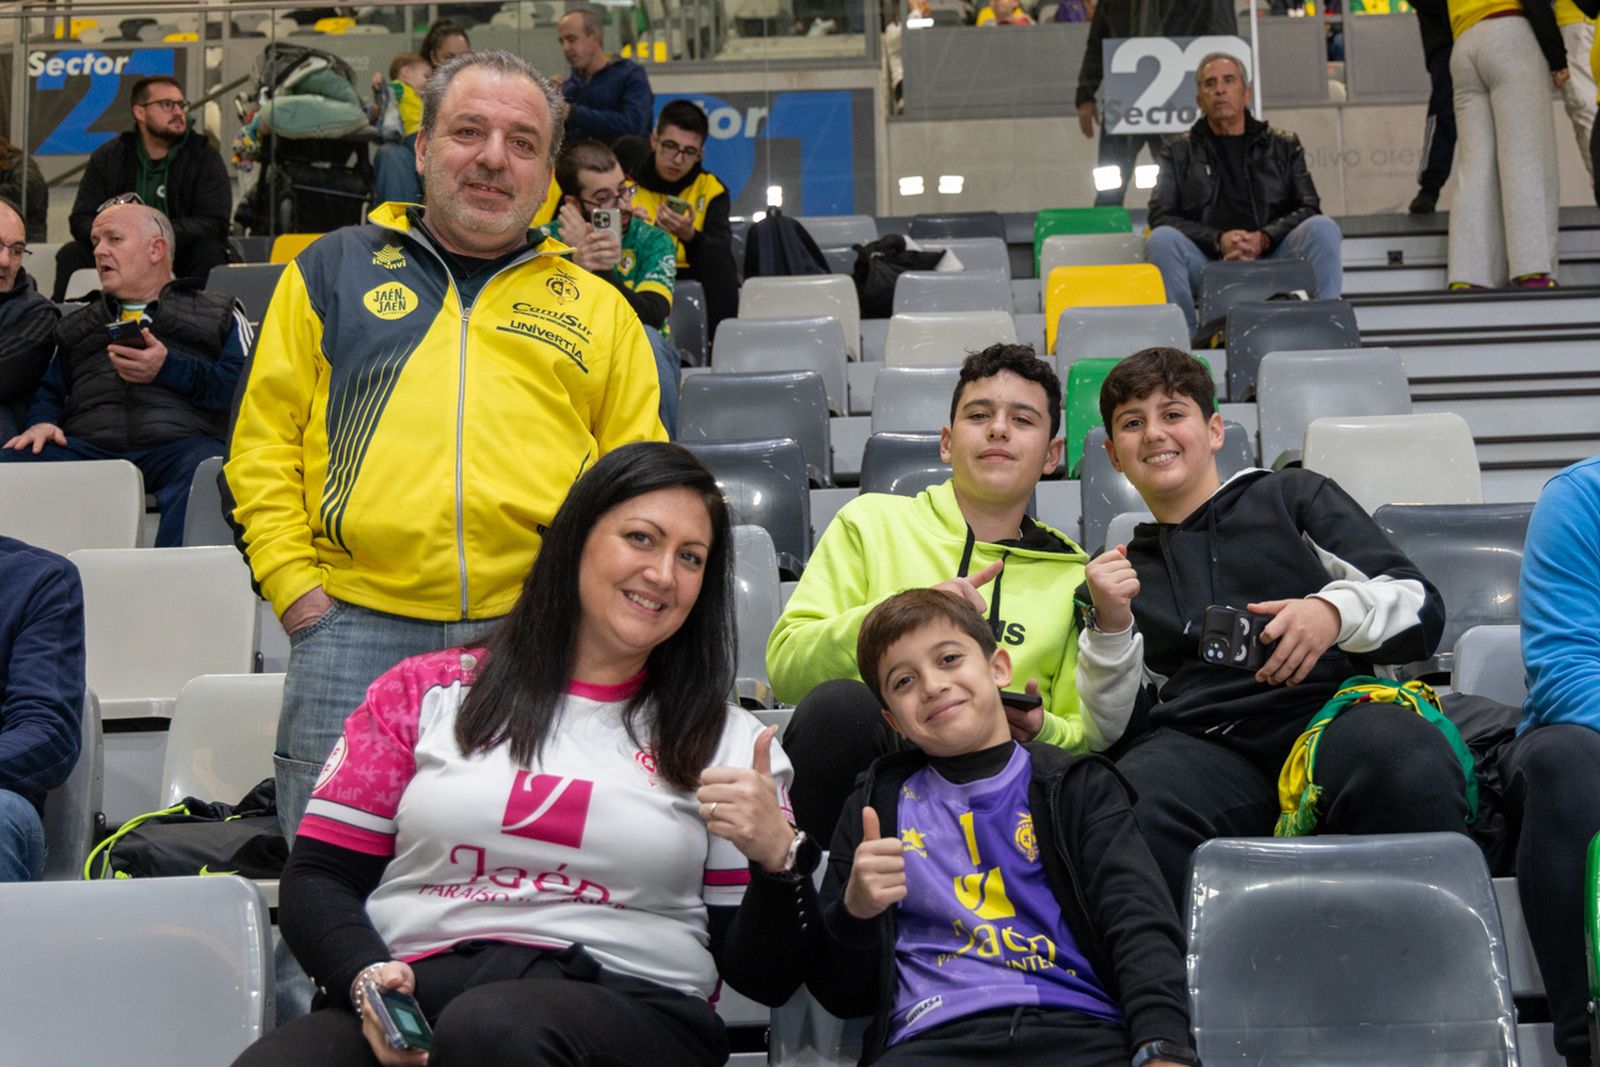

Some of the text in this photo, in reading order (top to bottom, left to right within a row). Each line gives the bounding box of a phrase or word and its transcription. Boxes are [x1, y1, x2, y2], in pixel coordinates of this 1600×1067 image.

[28, 51, 129, 76] Sector
[1105, 100, 1198, 127] Secto
[512, 302, 593, 336] CamiSur
[959, 811, 981, 867] 1
